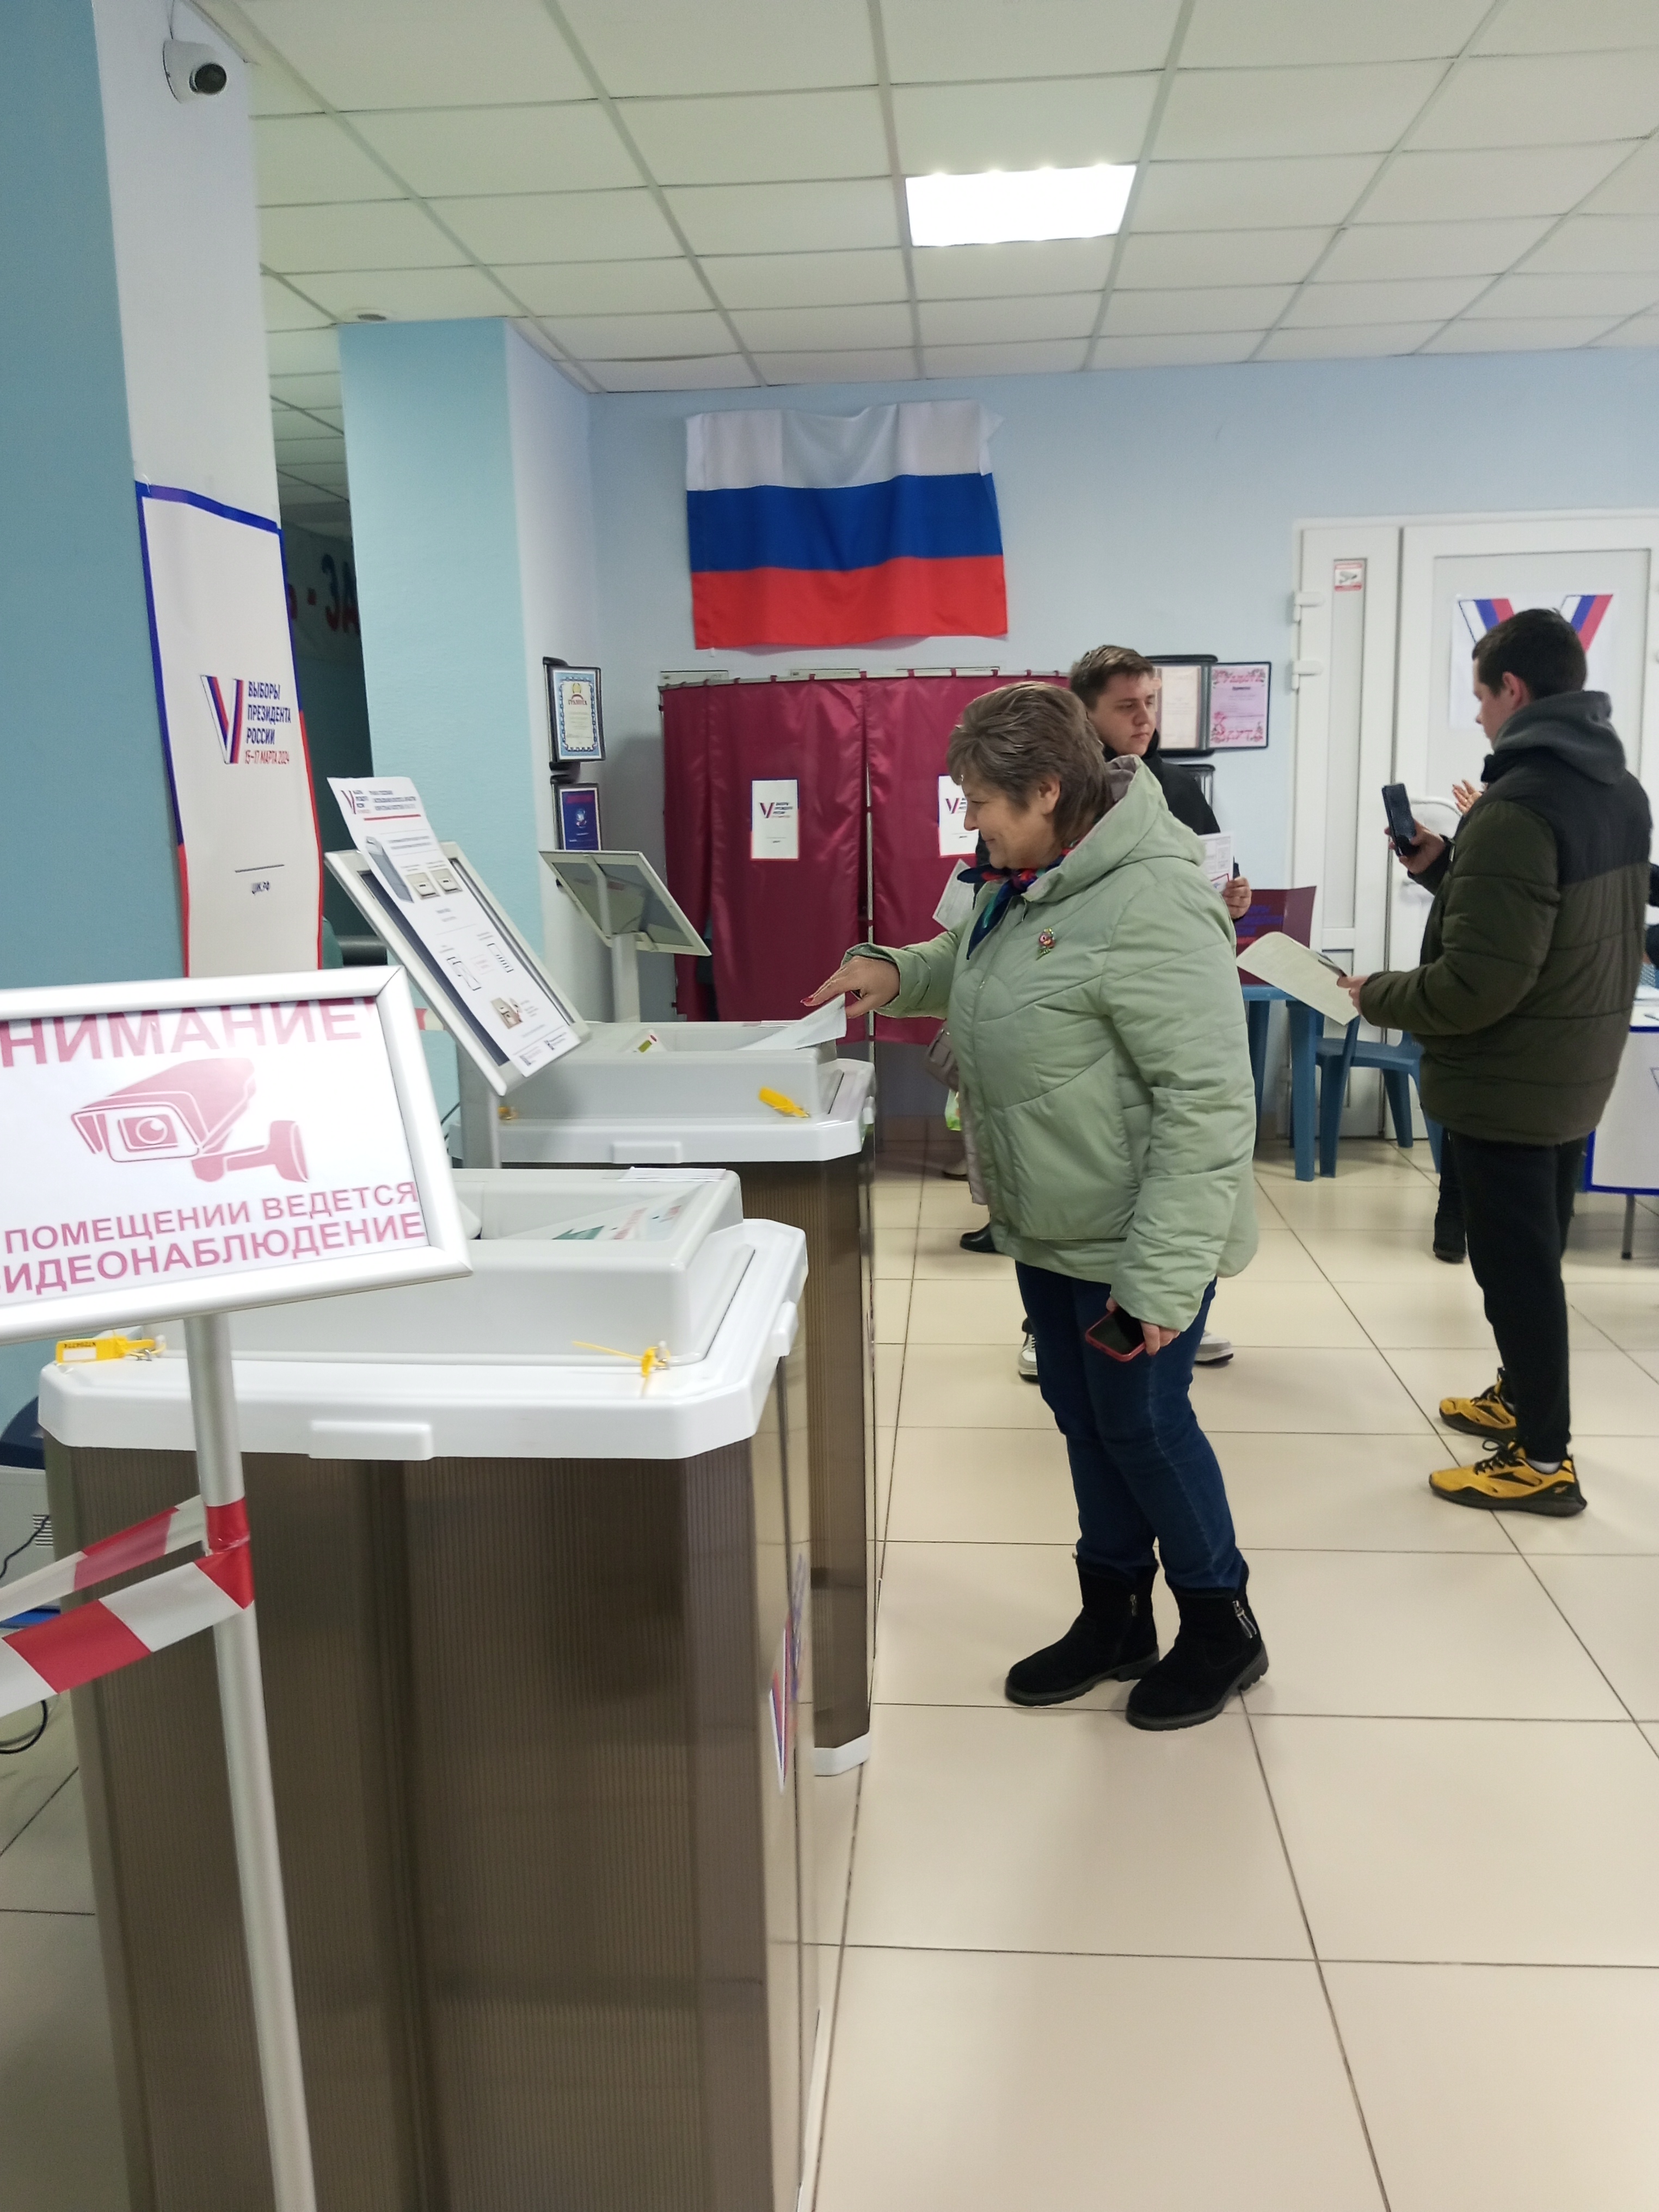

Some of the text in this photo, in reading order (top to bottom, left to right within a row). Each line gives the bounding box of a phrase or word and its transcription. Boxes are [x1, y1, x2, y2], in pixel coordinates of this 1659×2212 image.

[248, 680, 280, 701] ВЫБОРЫ
[247, 704, 292, 726] ПРЕЗИДЕНТА
[246, 727, 275, 745] РОССИИ
[261, 751, 277, 764] МАРТА
[278, 751, 290, 764] 2024
[4, 1182, 418, 1254] ПОМЕЩЕНИИ ВЕДЕТСЯ
[0, 1212, 426, 1295] ИДЕОНАБЛЮДЕНИЕ
